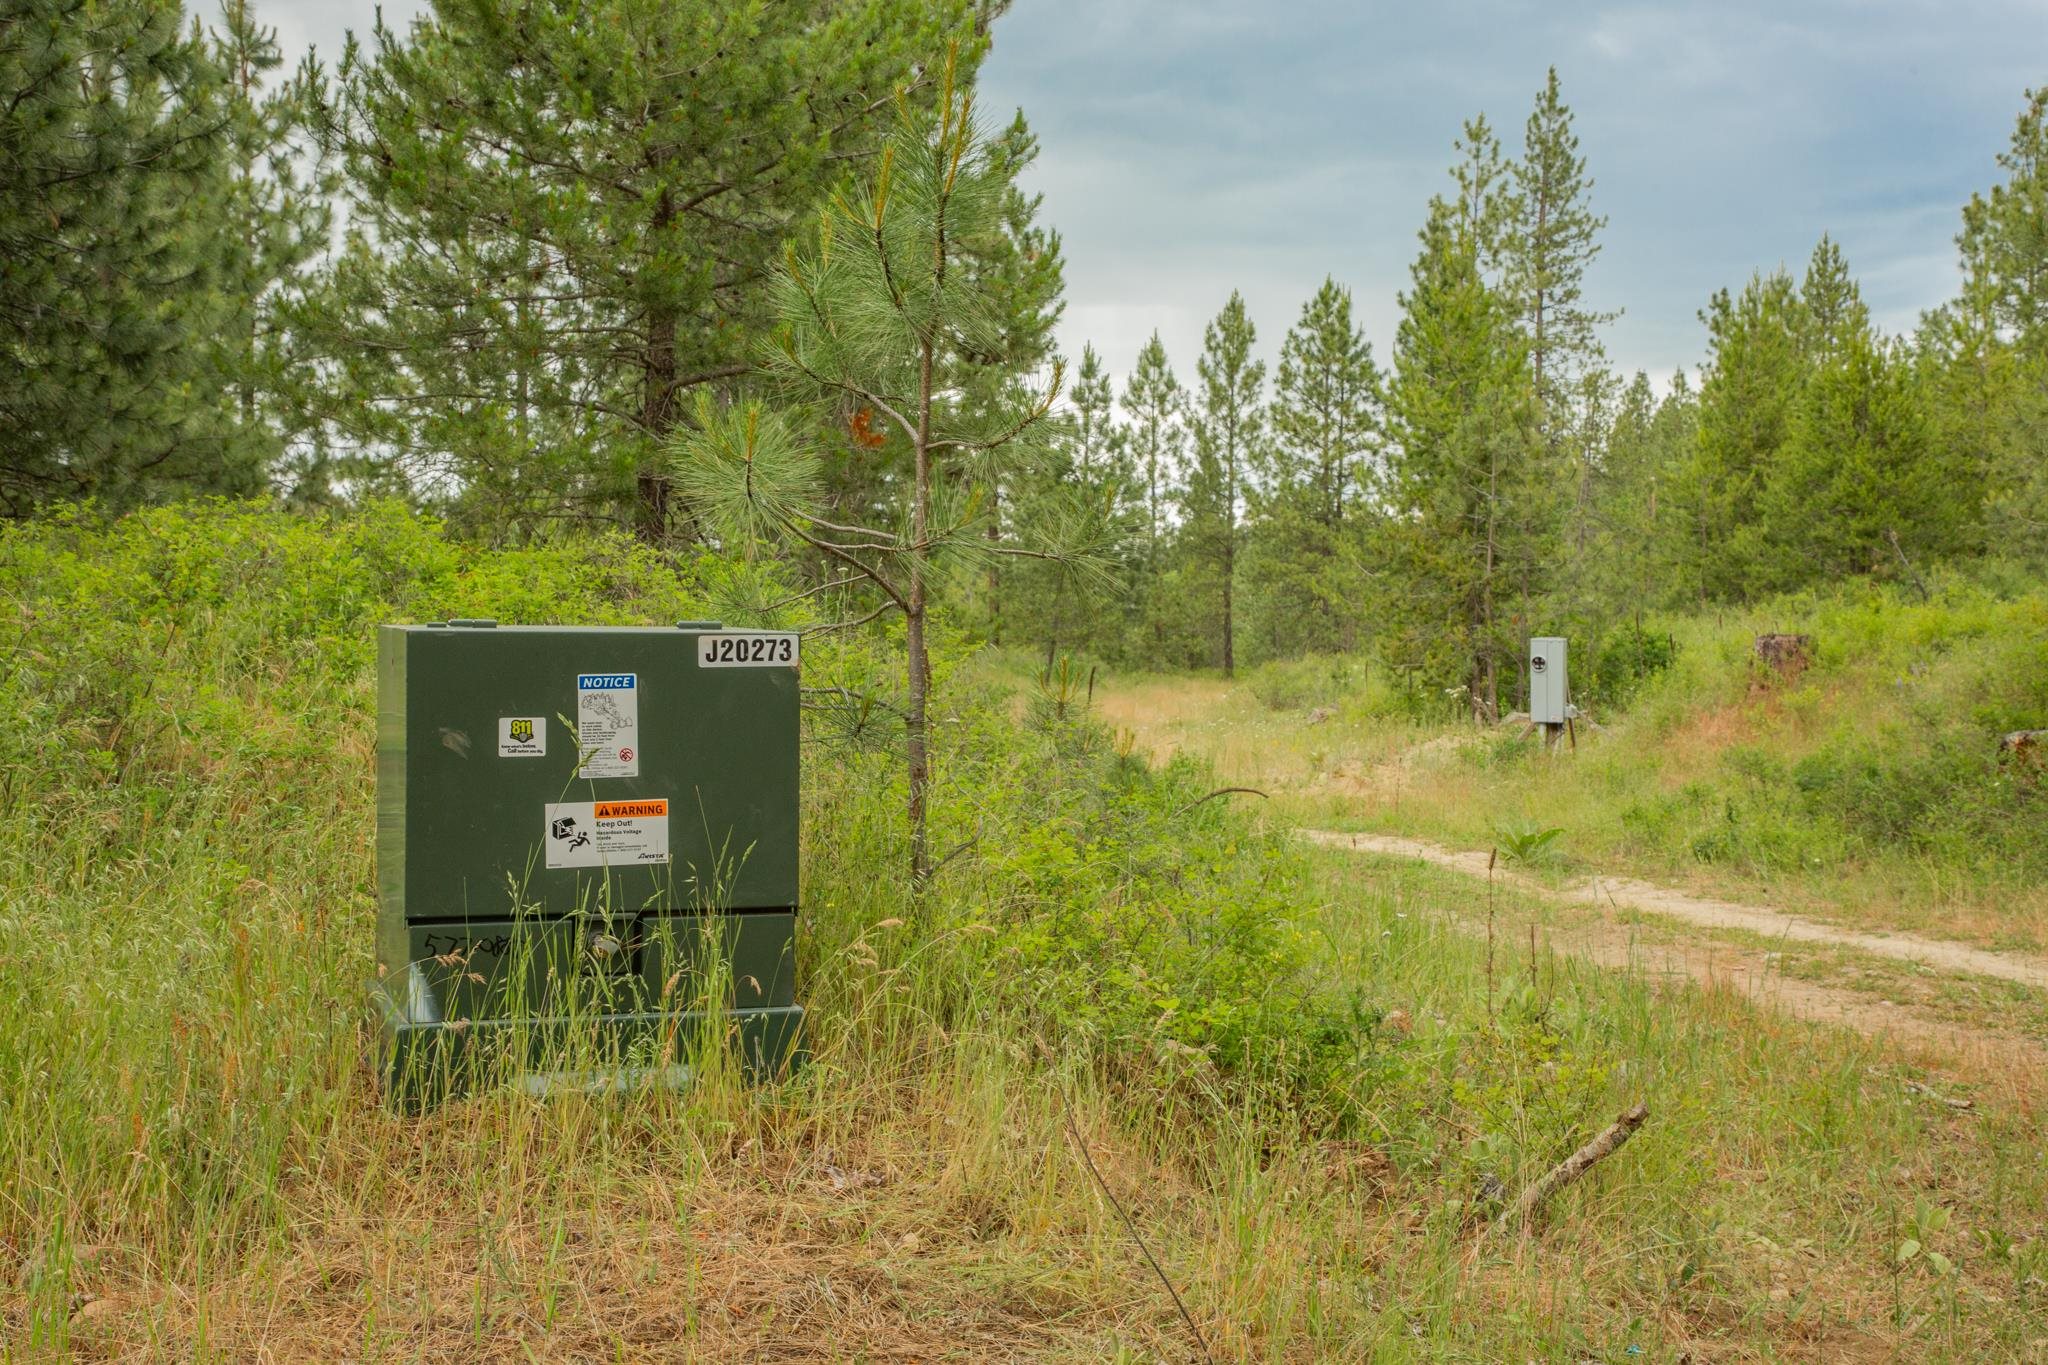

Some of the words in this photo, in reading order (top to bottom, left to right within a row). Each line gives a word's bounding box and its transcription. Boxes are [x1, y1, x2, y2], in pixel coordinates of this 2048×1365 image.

[705, 638, 792, 662] J20273
[583, 677, 631, 688] NOTICE
[511, 720, 532, 735] 811
[612, 805, 663, 815] WARNING
[596, 821, 616, 829] Keep
[616, 819, 633, 827] Out!
